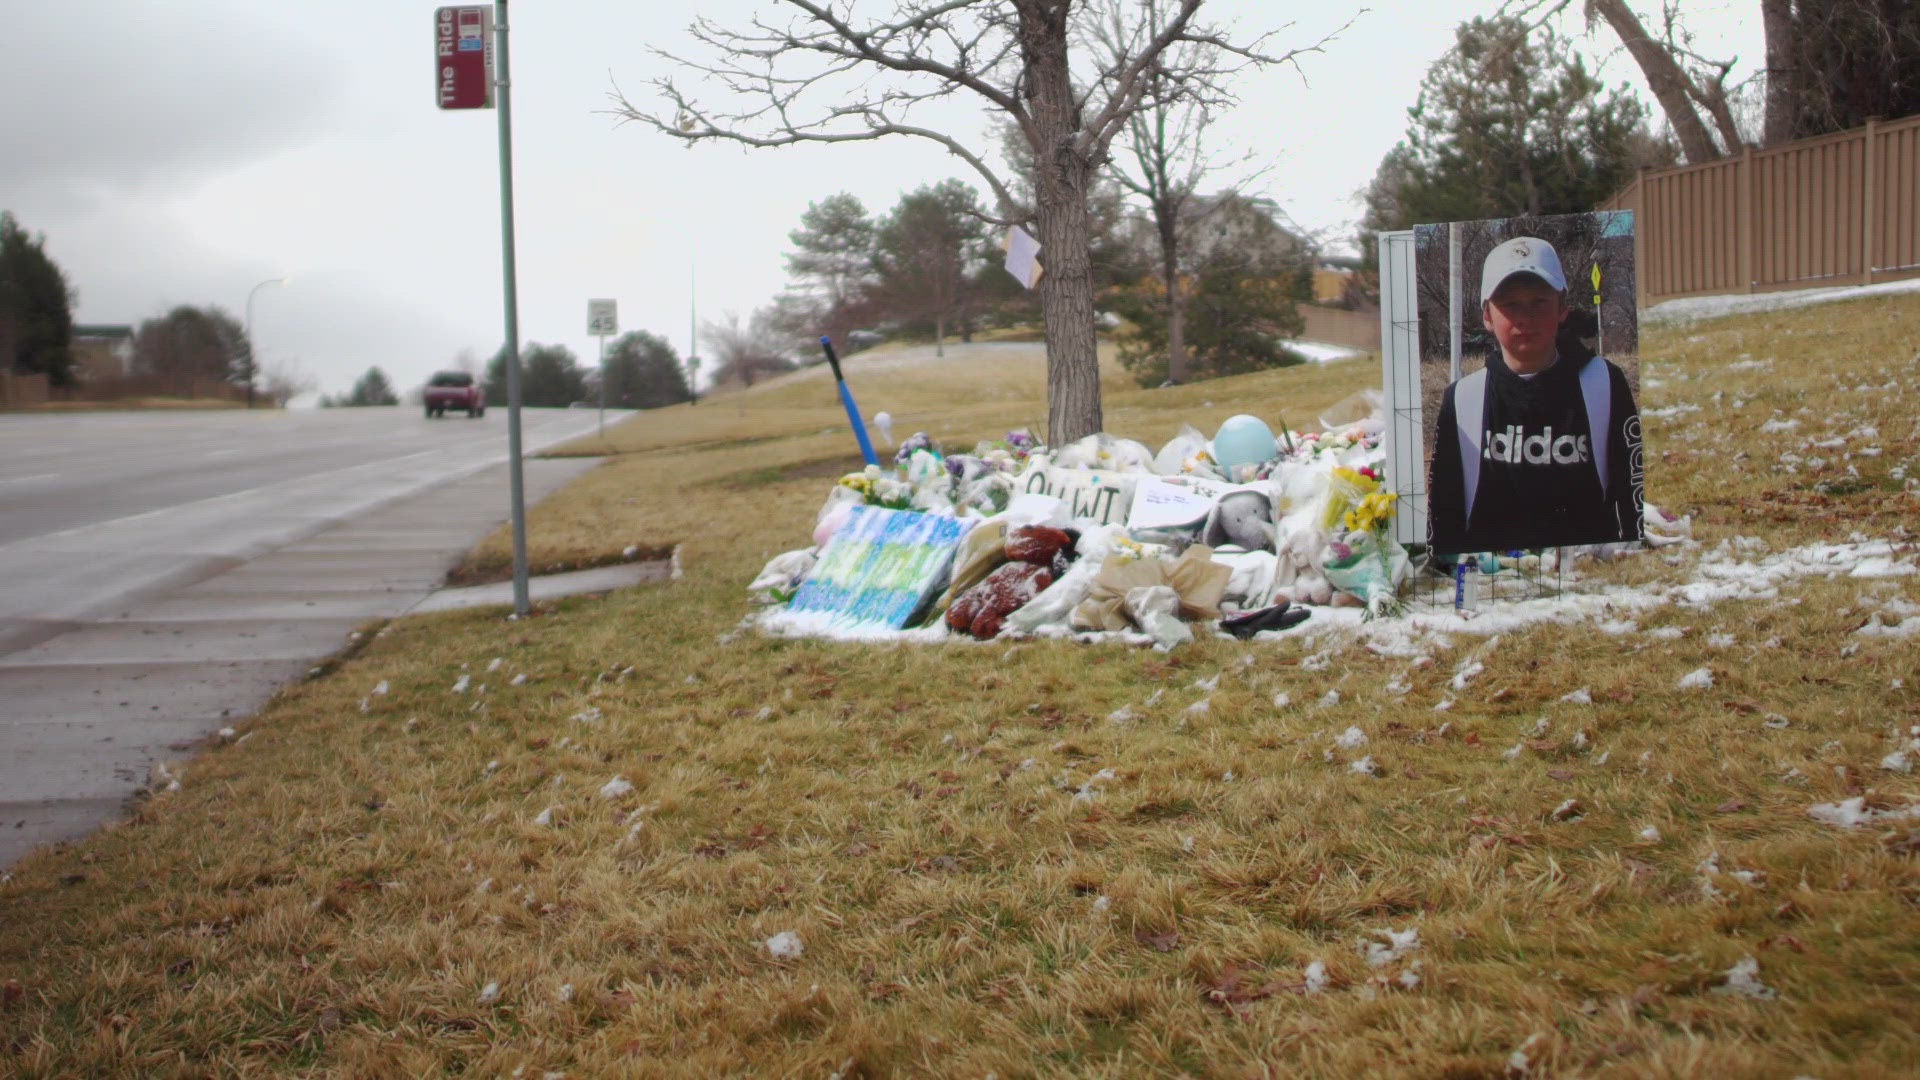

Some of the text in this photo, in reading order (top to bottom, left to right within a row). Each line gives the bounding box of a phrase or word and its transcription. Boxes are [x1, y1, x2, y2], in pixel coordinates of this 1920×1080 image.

[439, 9, 455, 105] The Ride
[591, 317, 616, 331] 45
[1484, 425, 1588, 464] didas
